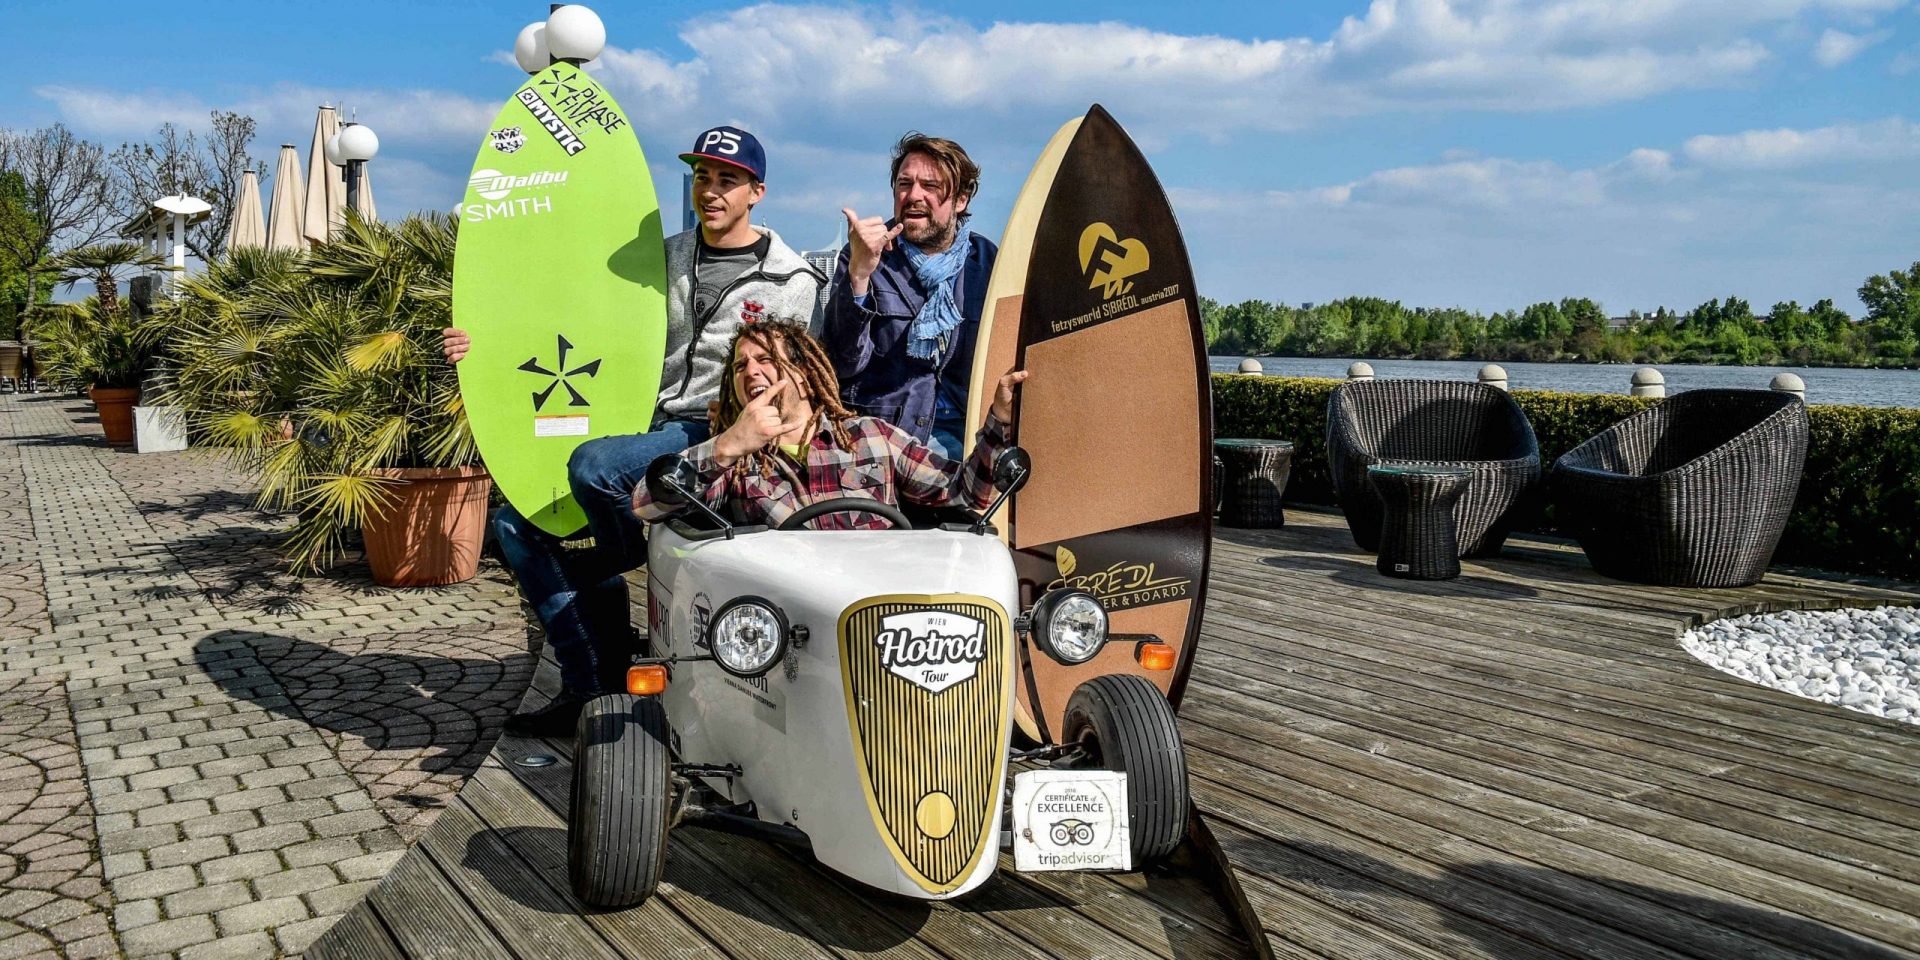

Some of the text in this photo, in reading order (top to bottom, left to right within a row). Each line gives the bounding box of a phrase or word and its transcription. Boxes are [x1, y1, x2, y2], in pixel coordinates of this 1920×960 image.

[526, 98, 585, 155] MYSTIC
[701, 131, 742, 155] P5
[466, 195, 552, 222] SMITH
[1051, 308, 1101, 333] fetzysworld
[1134, 584, 1186, 604] BOARDS
[927, 617, 947, 626] WIEN
[876, 623, 985, 665] Hotrod
[921, 670, 949, 683] Tour
[1037, 803, 1104, 812] EXCELLENCE
[1044, 794, 1089, 802] CERTIFICATE
[1038, 851, 1105, 867] tripadvisor
